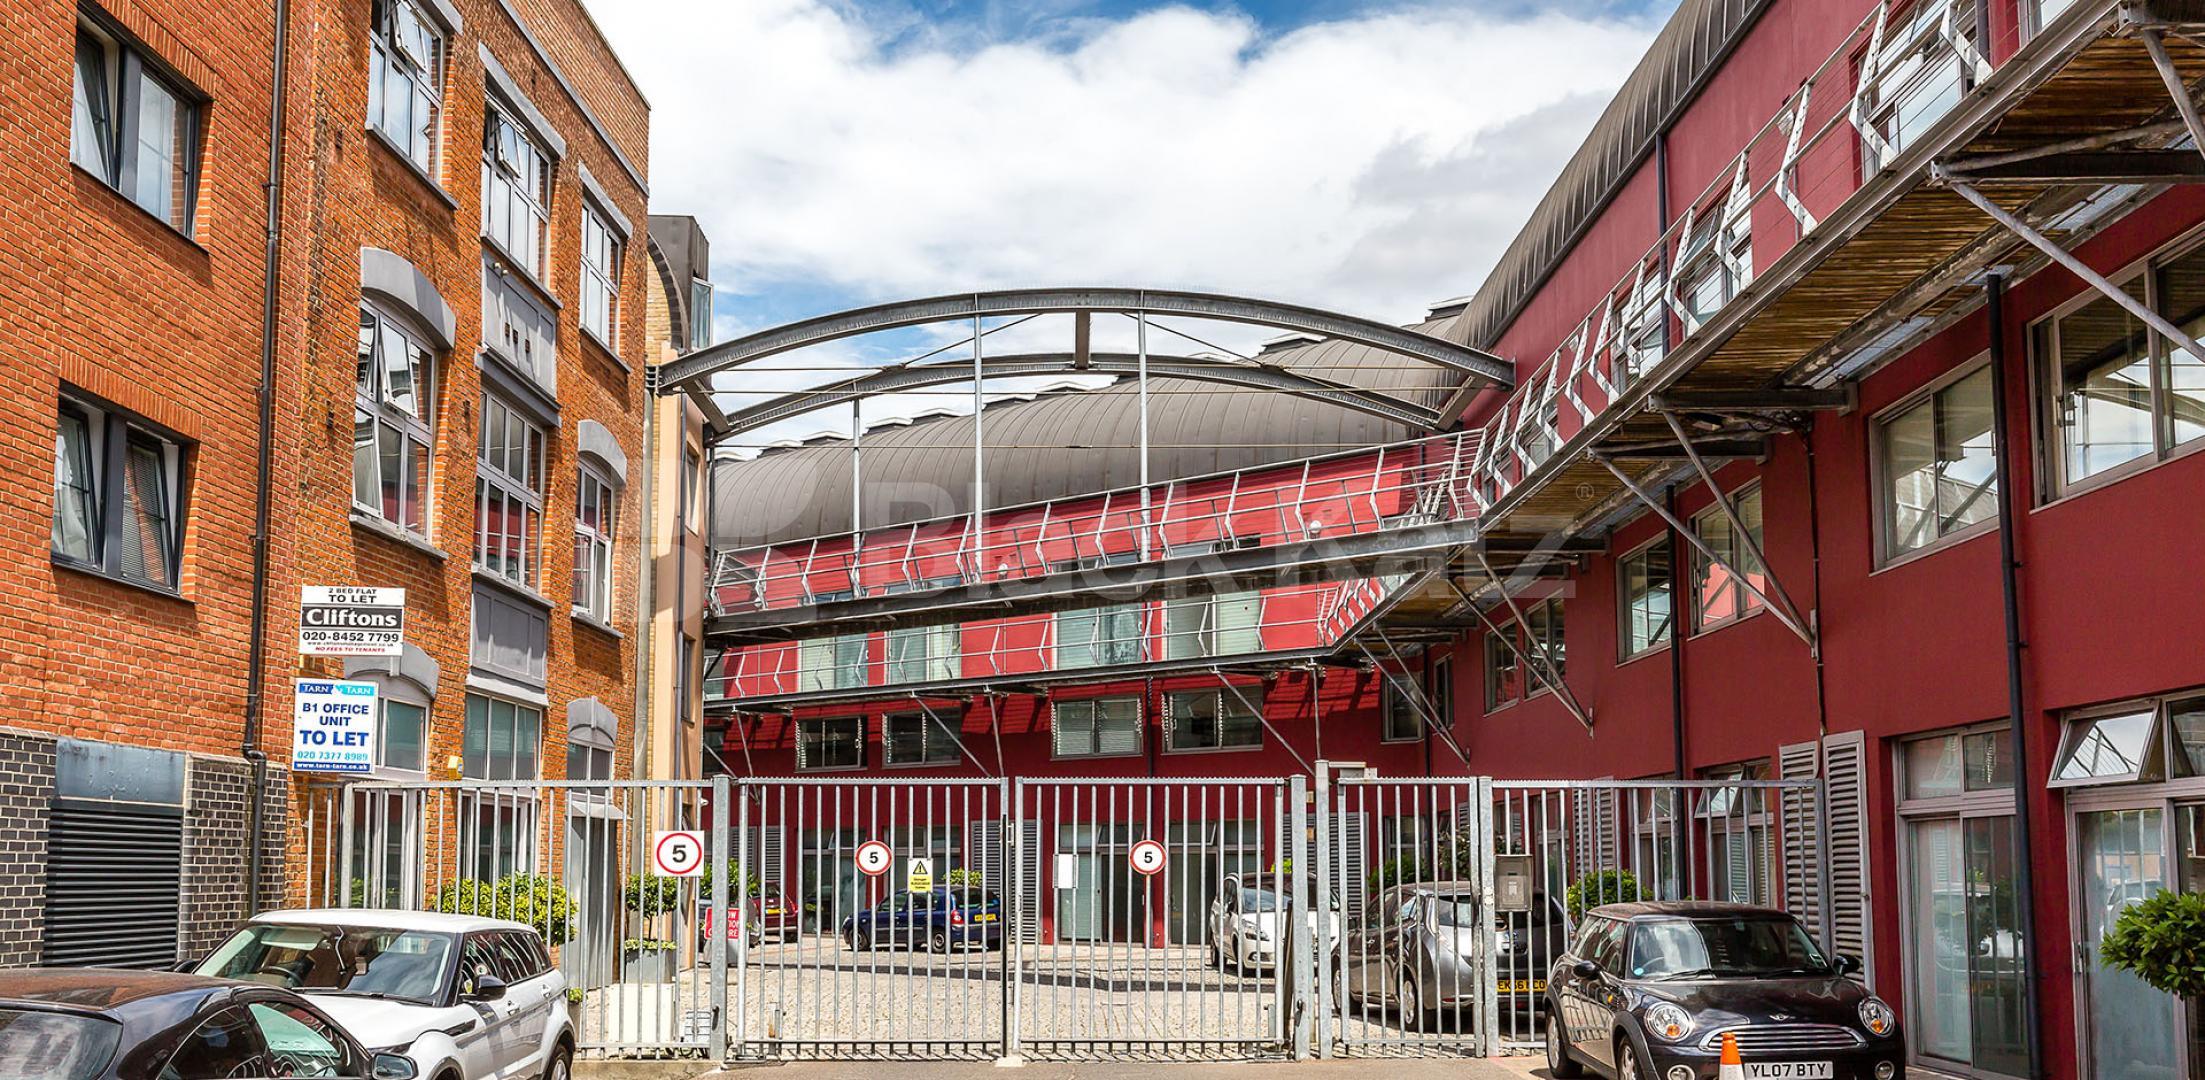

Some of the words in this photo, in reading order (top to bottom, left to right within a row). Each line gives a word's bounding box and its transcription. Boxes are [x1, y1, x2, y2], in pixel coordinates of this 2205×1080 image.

[328, 594, 347, 603] TO
[351, 595, 377, 604] LET
[306, 608, 398, 627] Cliftons
[302, 632, 365, 641] 020-8452
[368, 633, 399, 643] 7799
[302, 703, 318, 712] B1
[323, 703, 370, 715] OFFICE
[319, 716, 352, 727] UNIT
[299, 730, 327, 746] TO
[333, 731, 370, 747] LET
[297, 751, 316, 759] 020
[319, 752, 342, 760] 7377
[344, 752, 369, 761] 8989
[672, 844, 687, 863] 5
[869, 851, 879, 864] 5
[1143, 851, 1153, 864] 5
[1750, 1064, 1792, 1078] YL07
[1796, 1063, 1827, 1077] BTY
